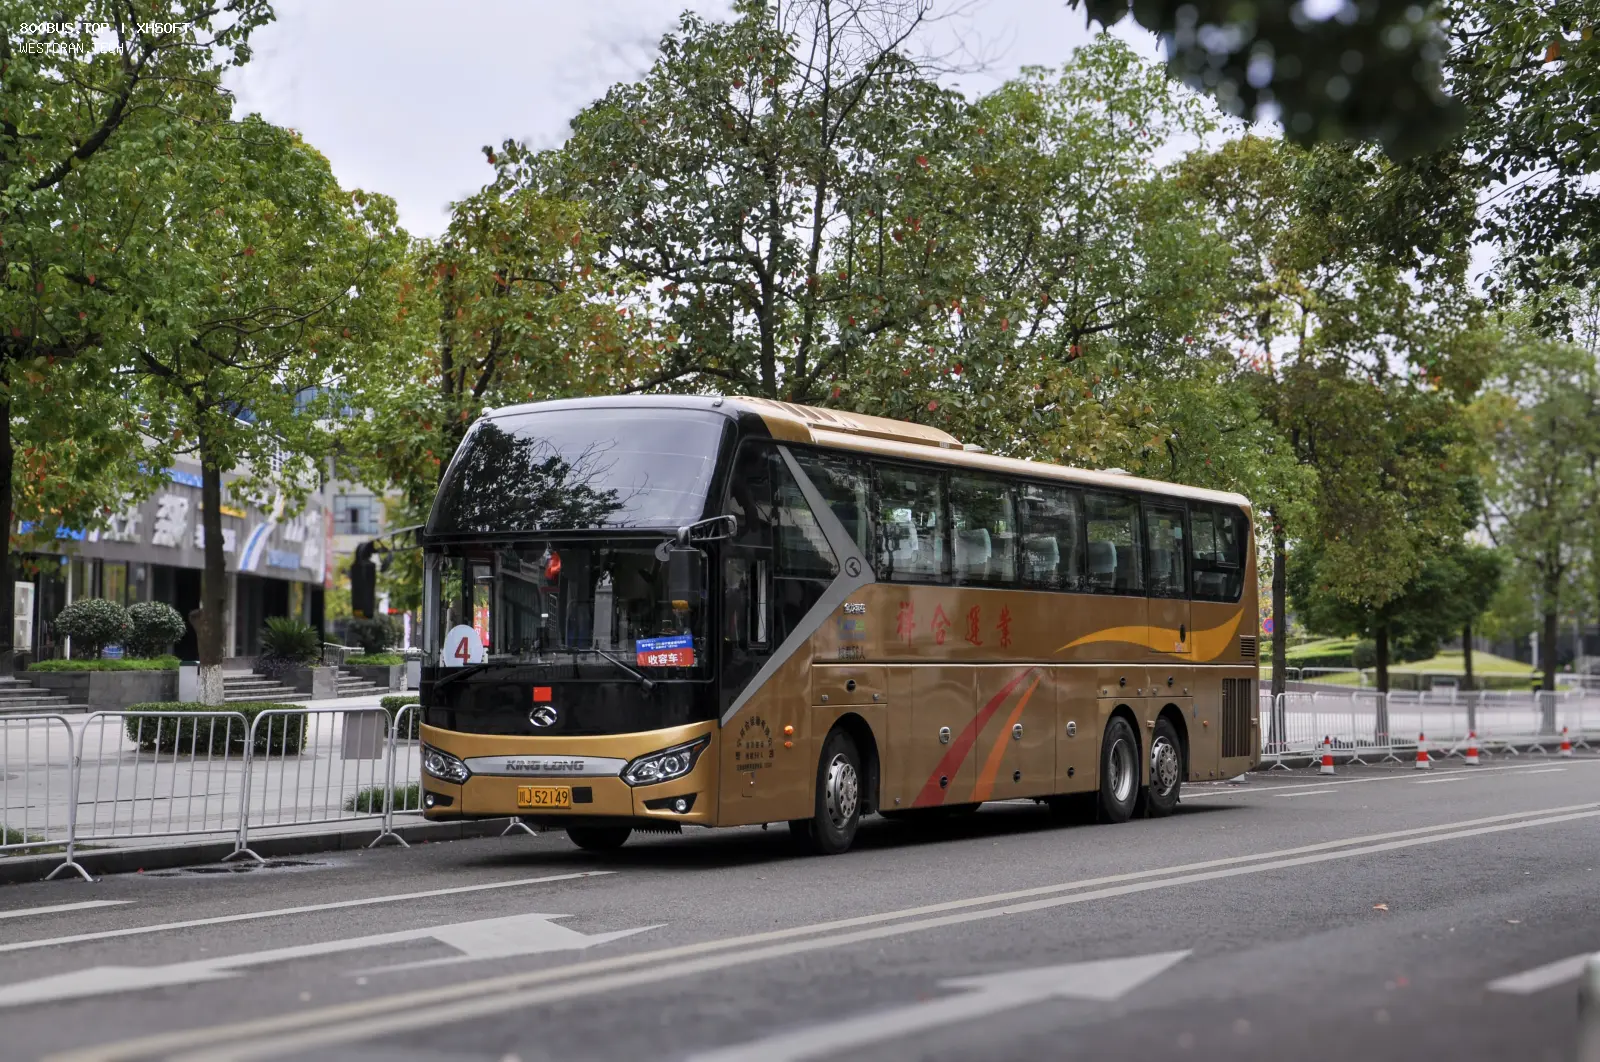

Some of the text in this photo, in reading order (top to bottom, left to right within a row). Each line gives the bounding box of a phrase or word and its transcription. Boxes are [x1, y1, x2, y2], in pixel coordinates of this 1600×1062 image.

[454, 636, 471, 665] 4
[647, 652, 679, 665] 收容车
[505, 760, 585, 771] KING LONG
